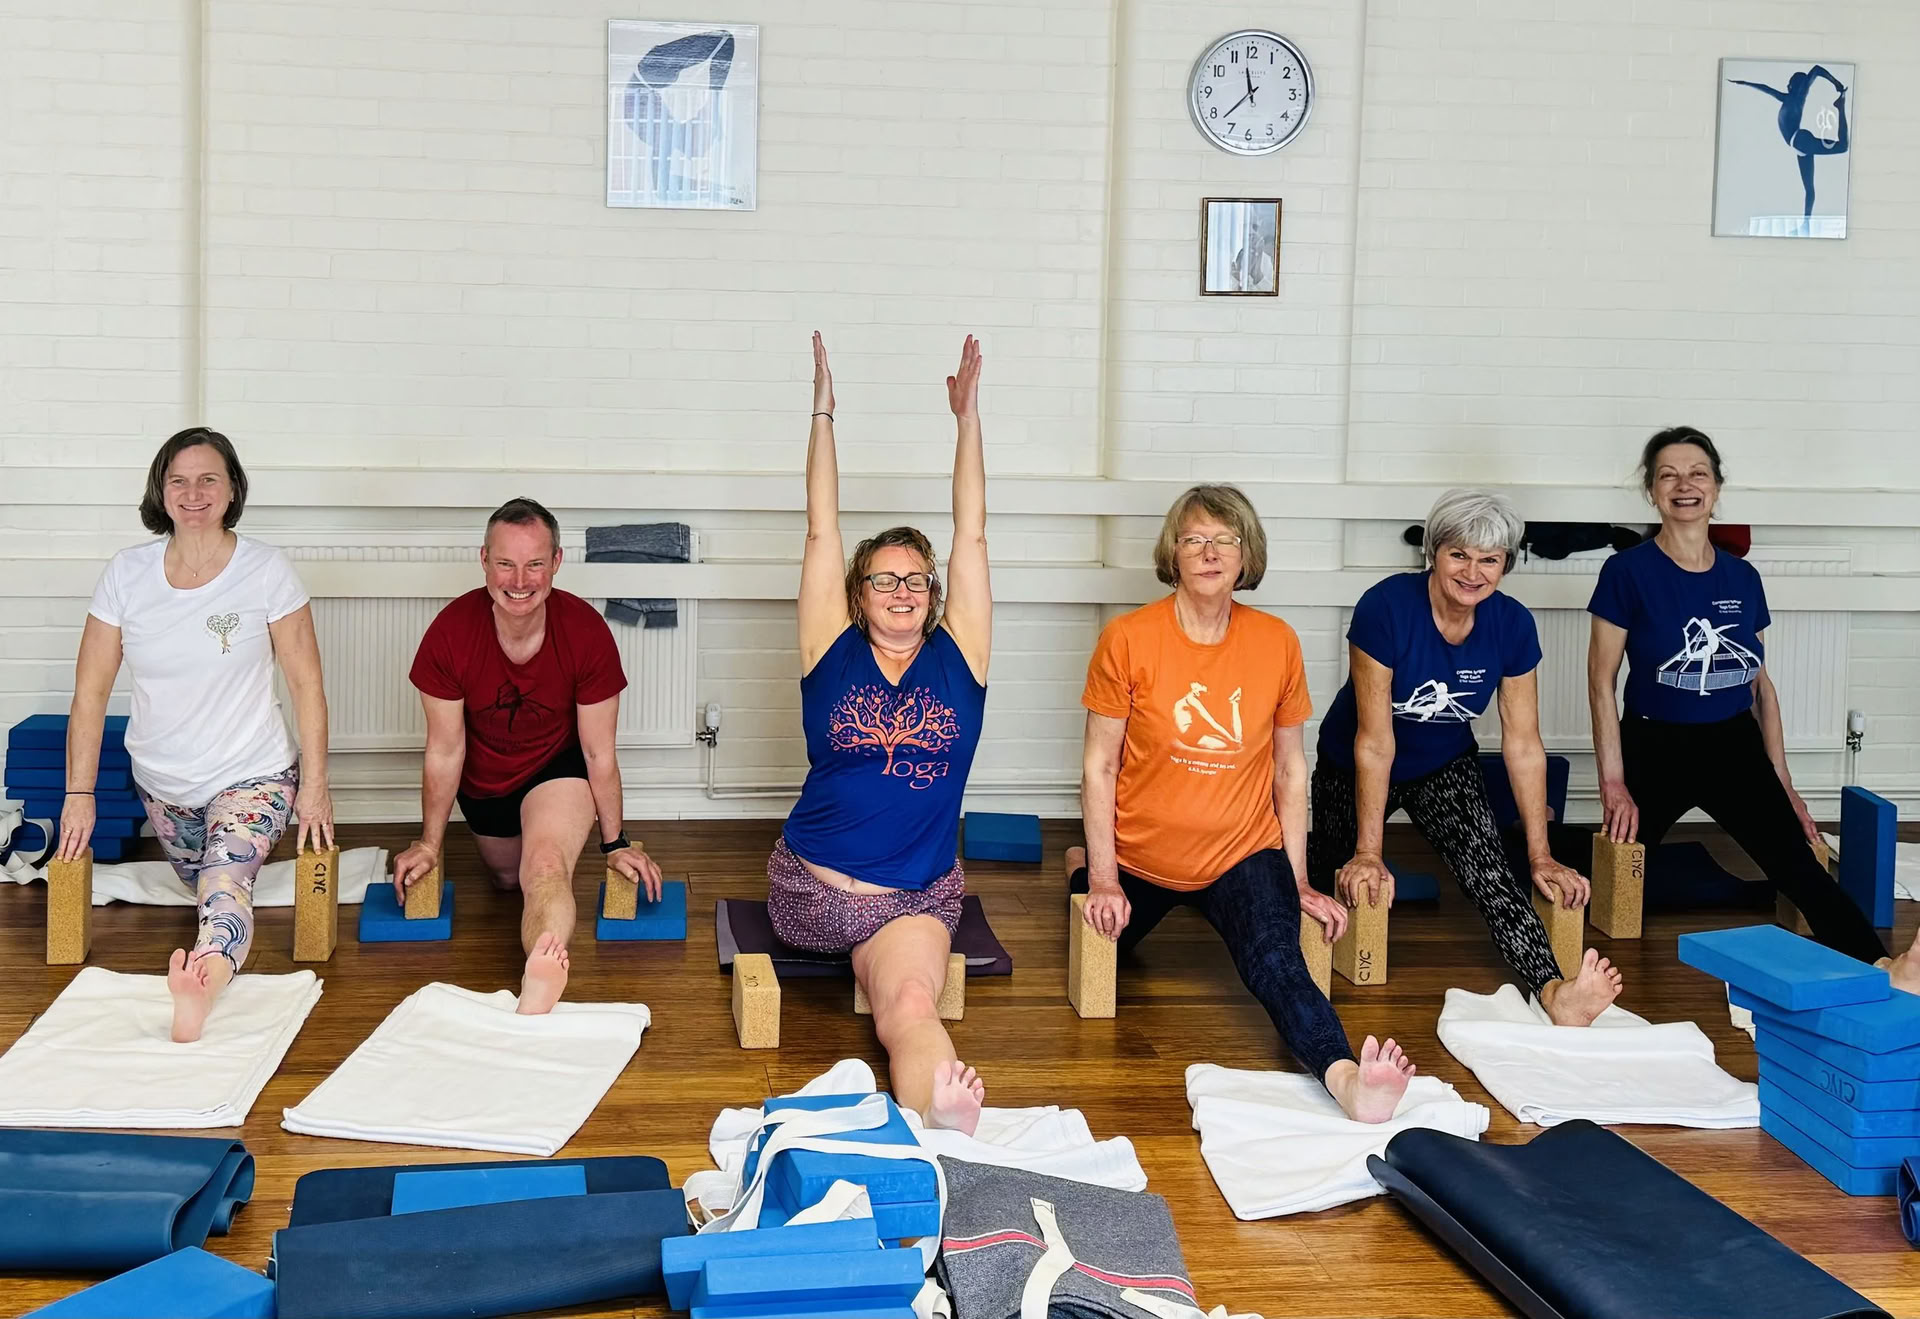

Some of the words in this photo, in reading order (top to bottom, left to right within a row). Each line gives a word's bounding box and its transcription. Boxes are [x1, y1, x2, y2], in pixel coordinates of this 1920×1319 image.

[1230, 50, 1239, 64] 11
[1246, 45, 1259, 59] 12
[1269, 51, 1274, 65] 1
[1213, 64, 1226, 78] 10
[1282, 66, 1291, 79] 2
[1204, 85, 1213, 99] 9
[1288, 88, 1297, 101] 3
[1209, 106, 1218, 119] 8
[1280, 110, 1290, 121] 4
[1227, 122, 1237, 134] 7
[1244, 128, 1253, 141] 6
[1265, 123, 1274, 136] 5
[1632, 850, 1643, 879] CIYC
[312, 862, 327, 895] CIYC
[1359, 949, 1372, 982] CIYC
[1820, 1069, 1856, 1104] CIYC
